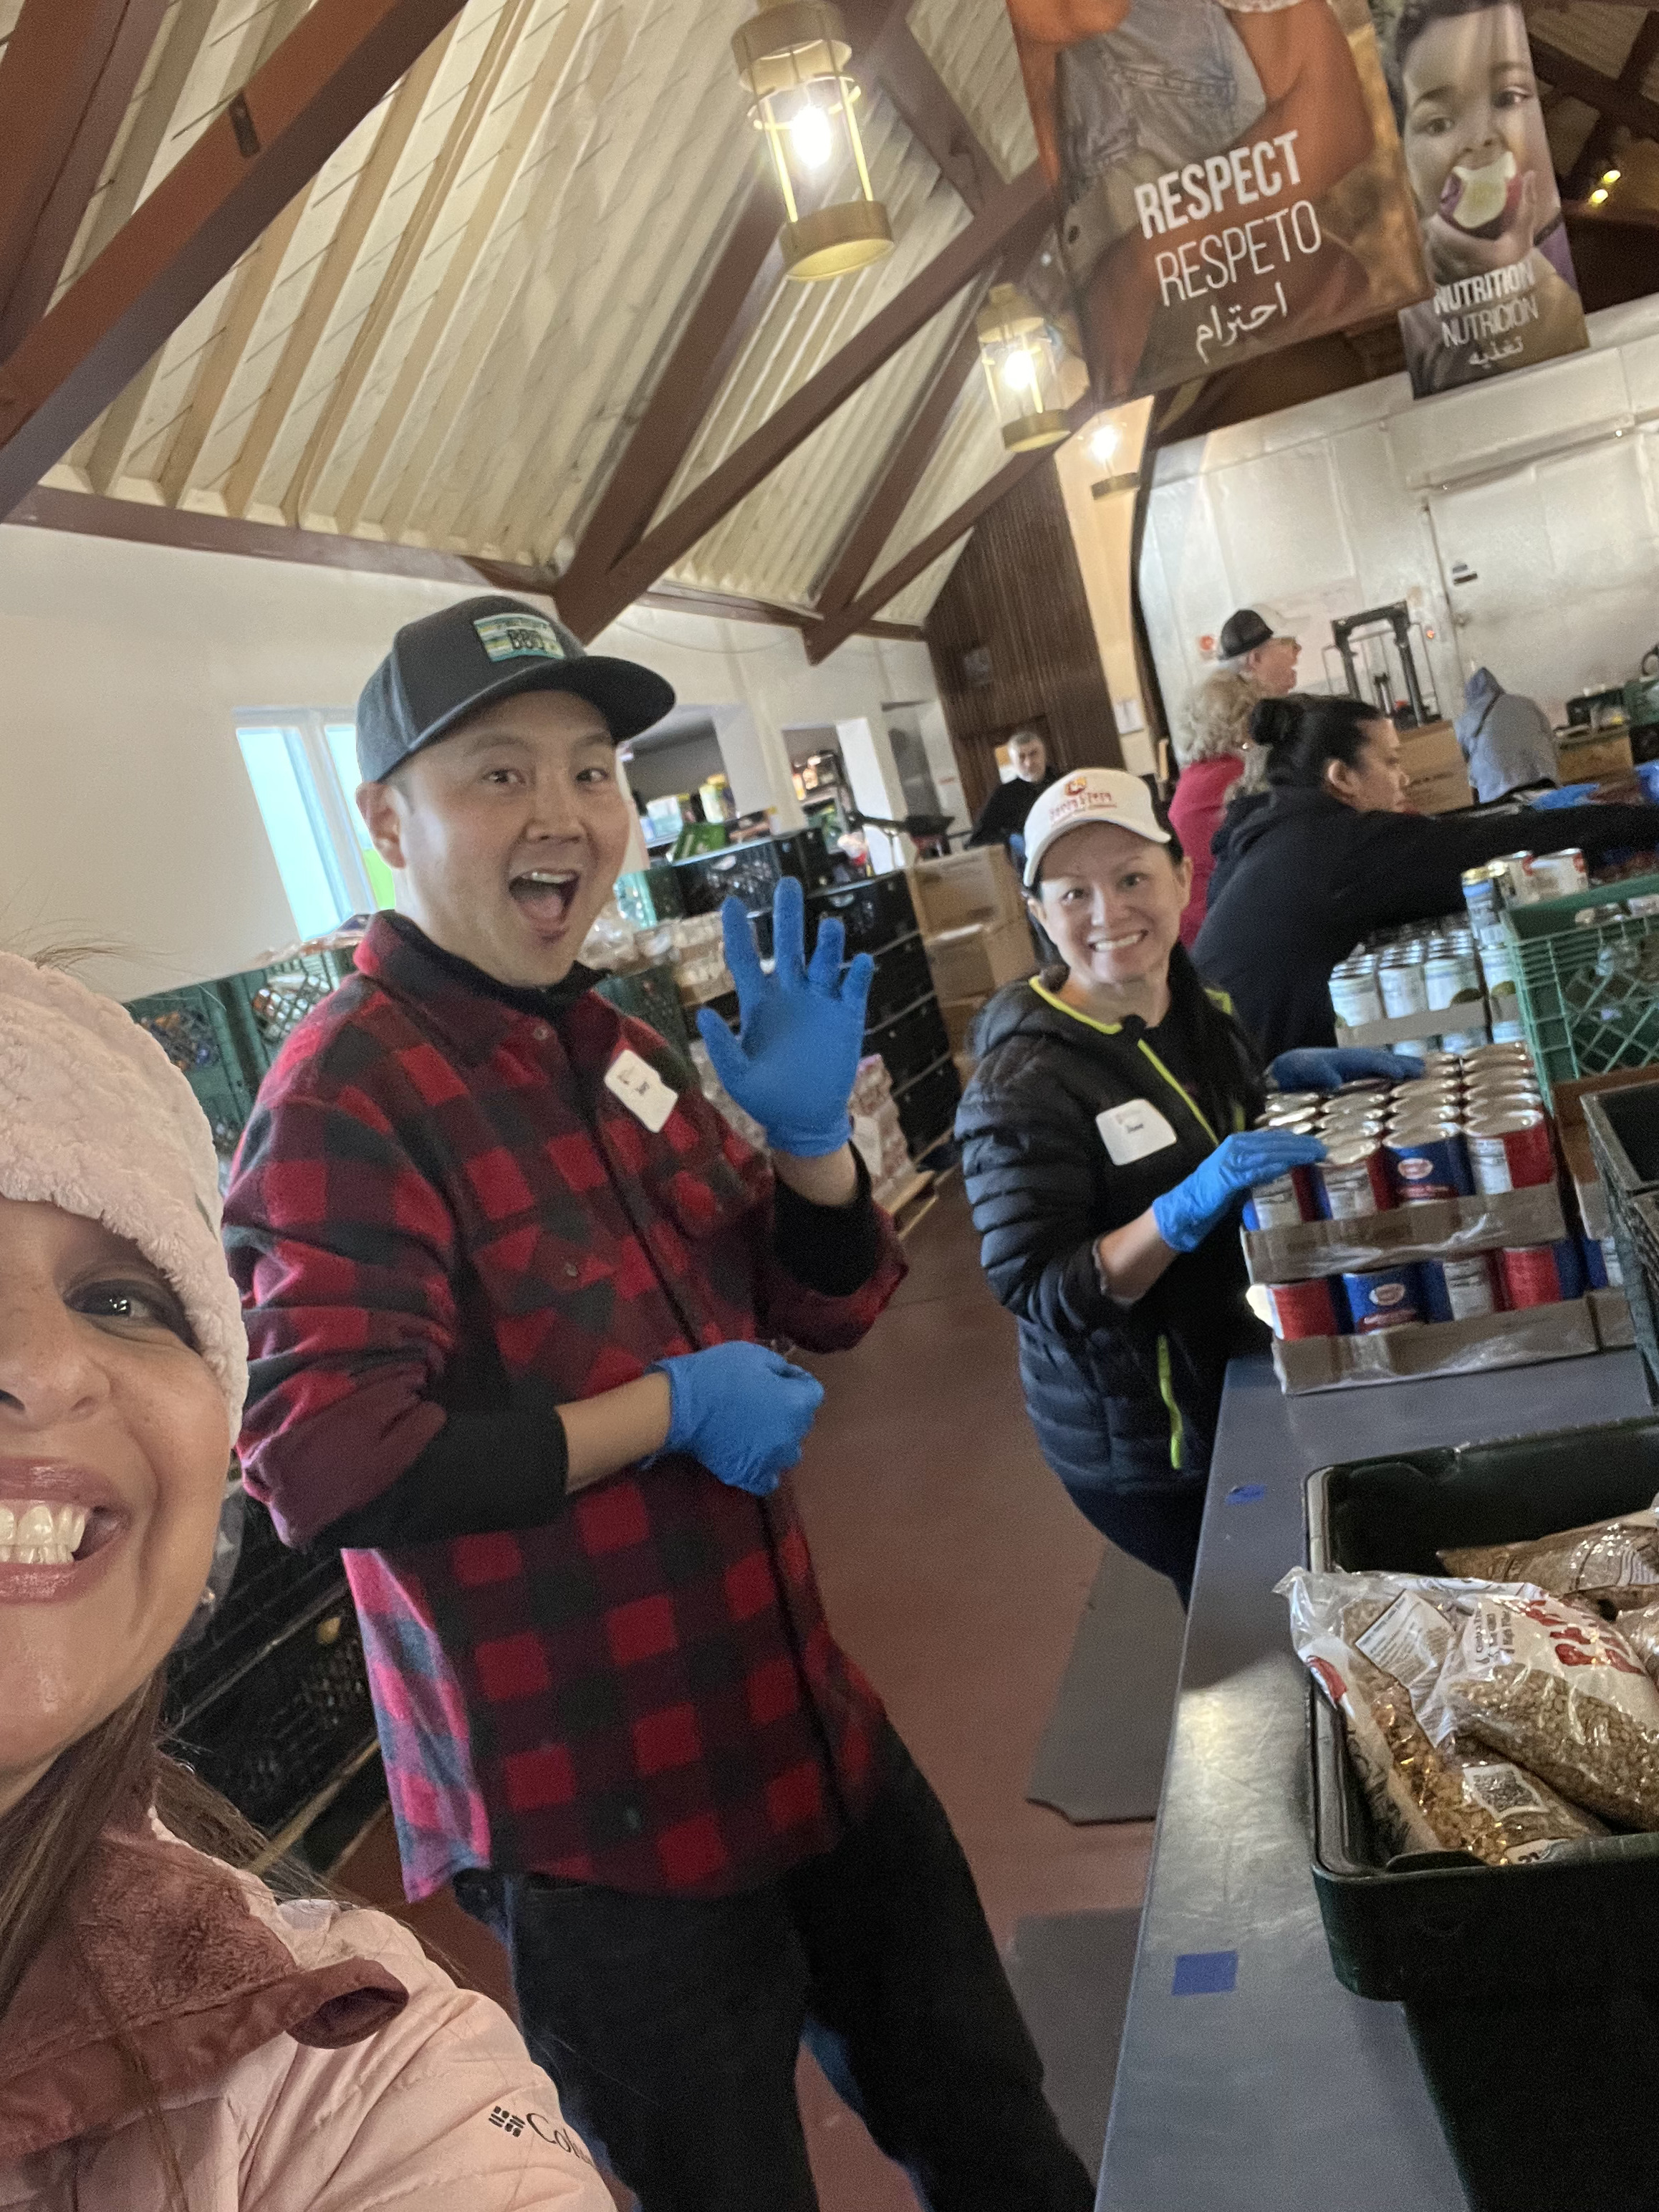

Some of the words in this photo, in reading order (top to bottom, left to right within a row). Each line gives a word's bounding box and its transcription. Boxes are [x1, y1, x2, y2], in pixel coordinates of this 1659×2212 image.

[1134, 130, 1301, 239] RESPECT
[1155, 200, 1322, 307] RESPETO
[1433, 261, 1536, 314] NUTRITION
[1196, 282, 1288, 364] احترام
